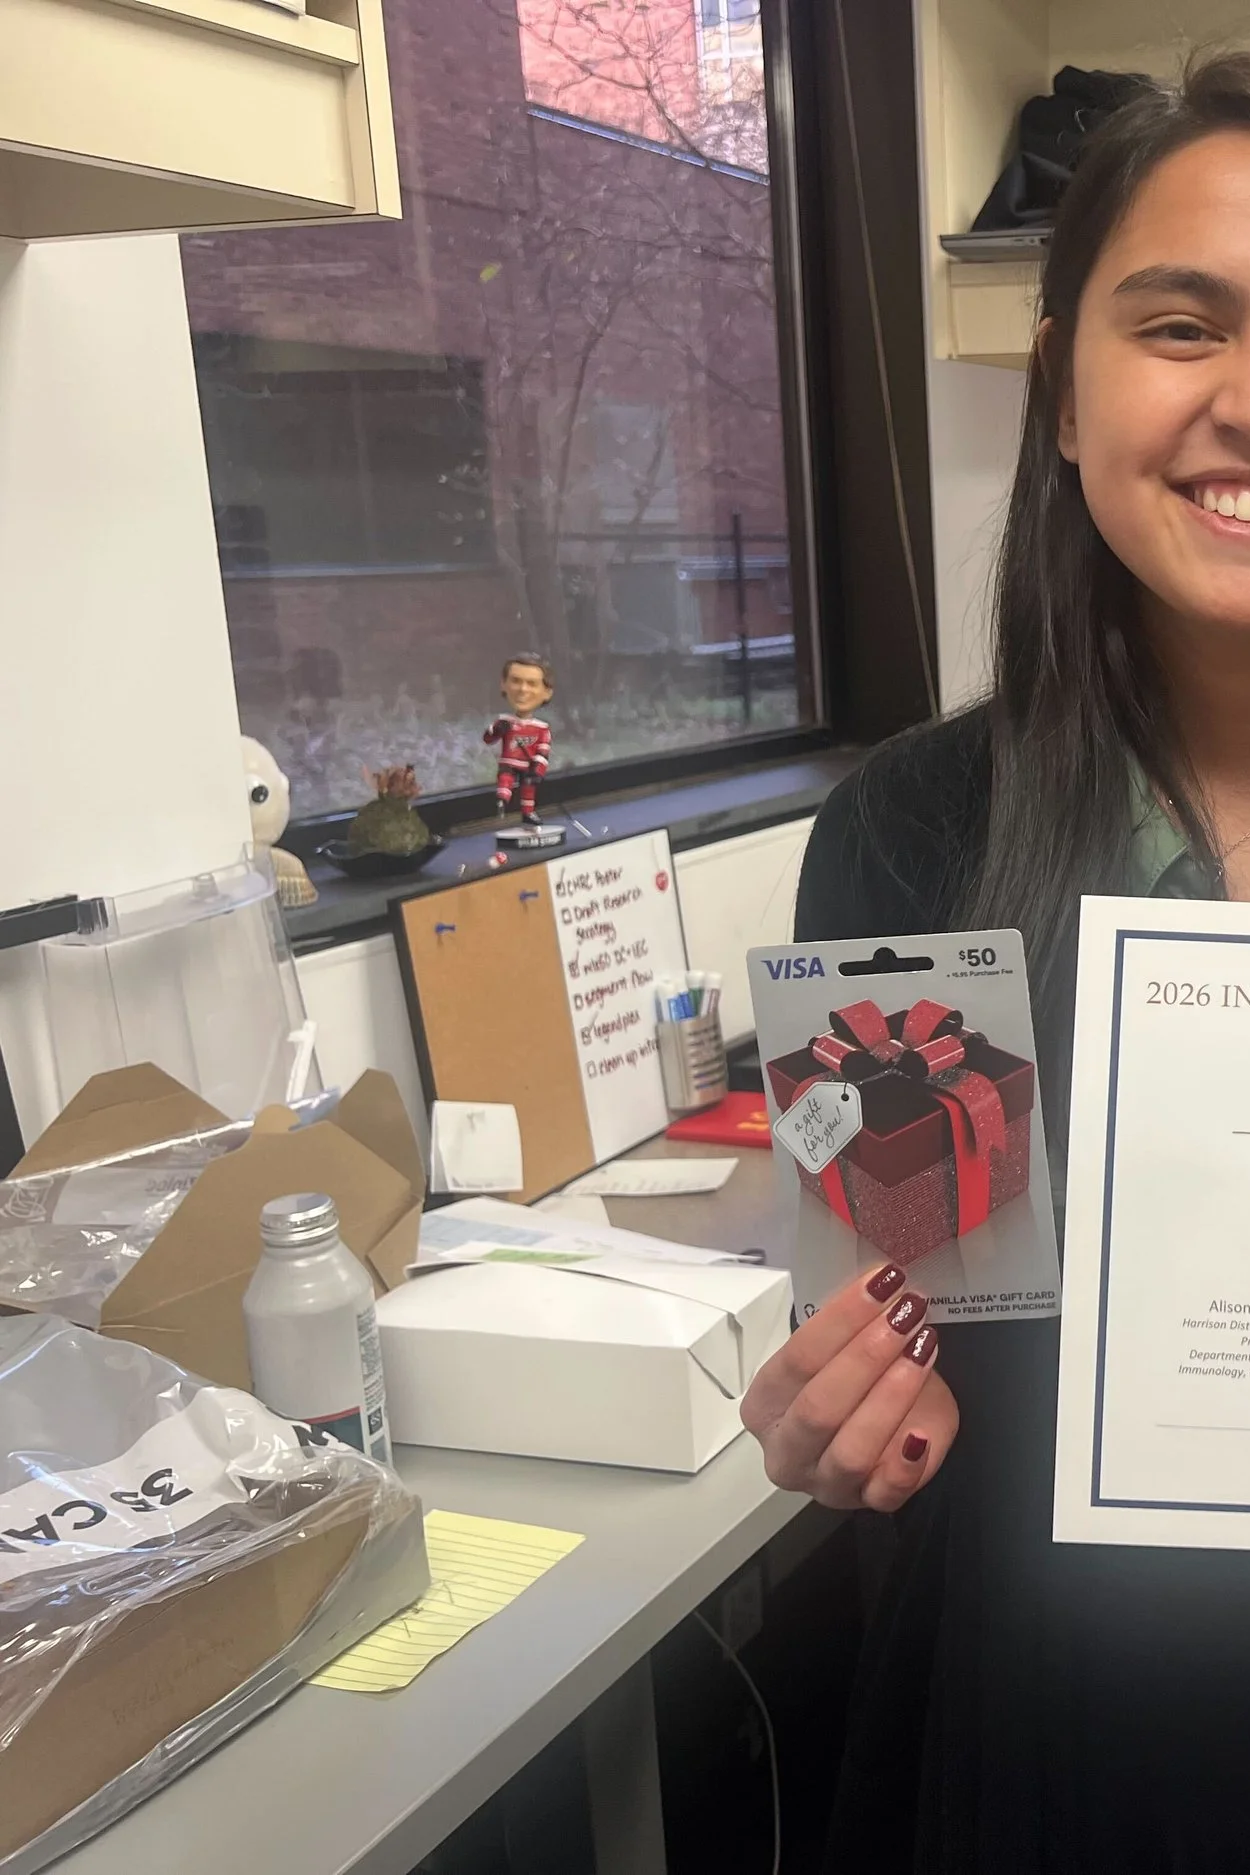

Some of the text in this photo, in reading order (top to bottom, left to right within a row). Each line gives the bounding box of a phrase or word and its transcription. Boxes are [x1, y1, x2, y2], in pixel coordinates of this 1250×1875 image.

[760, 947, 996, 980] VISA $50
[1146, 981, 1211, 1007] 2026
[795, 1098, 822, 1136] a gift
[803, 1135, 824, 1162] for
[1000, 1292, 1022, 1302] GIFT
[1026, 1291, 1055, 1300] CARD
[963, 1306, 983, 1314] FEES
[985, 1305, 1010, 1313] AFTER
[1013, 1302, 1056, 1311] PURCHASE
[1209, 1300, 1250, 1314] Alison
[1182, 1318, 1227, 1330] Harrison
[1189, 1349, 1250, 1363] Department
[1178, 1364, 1246, 1379] Immunology,
